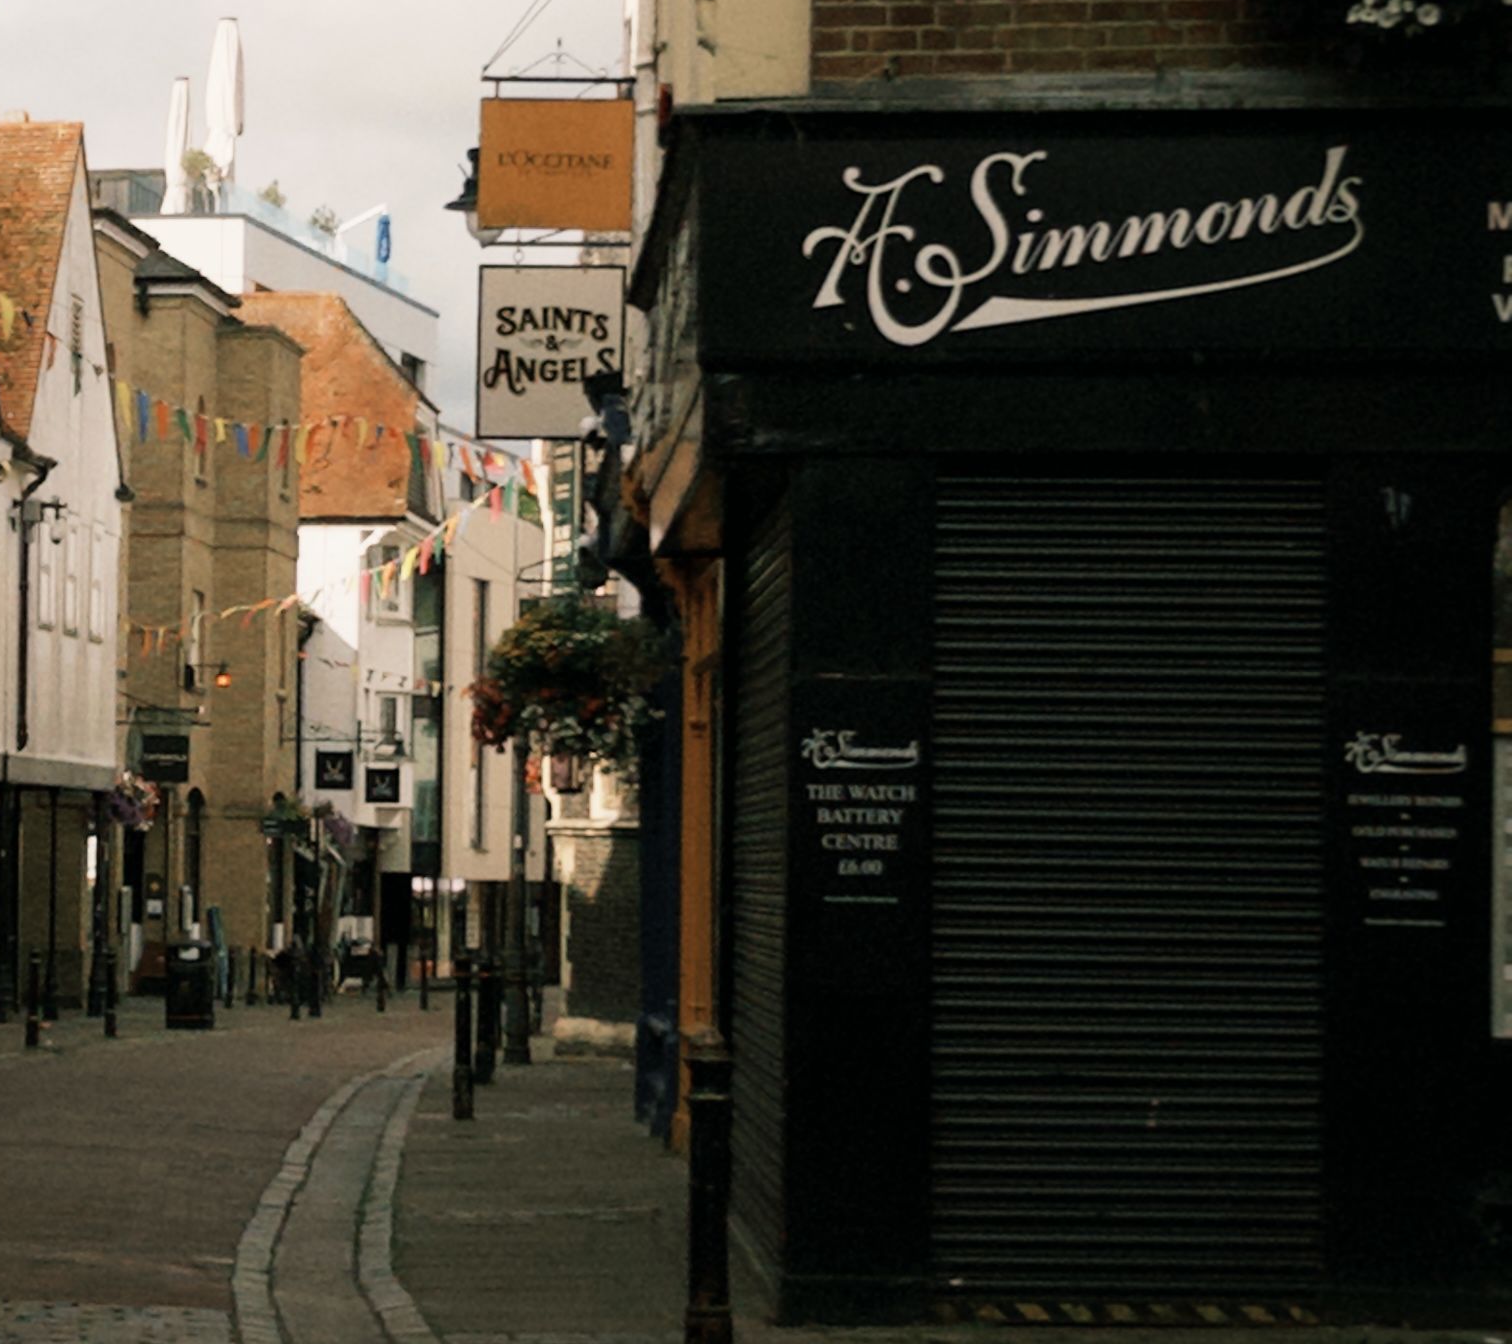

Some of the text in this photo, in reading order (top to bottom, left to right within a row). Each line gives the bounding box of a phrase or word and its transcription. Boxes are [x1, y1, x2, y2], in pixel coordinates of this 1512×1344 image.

[498, 150, 614, 170] L'OCCITANE
[914, 145, 1364, 296] Simmonds
[496, 306, 609, 341] SAINTS
[545, 335, 560, 352] &
[484, 348, 616, 394] ANGELS
[806, 784, 917, 802] THE WATCH
[816, 808, 904, 825] BATTERY
[820, 832, 899, 851] CENTRE
